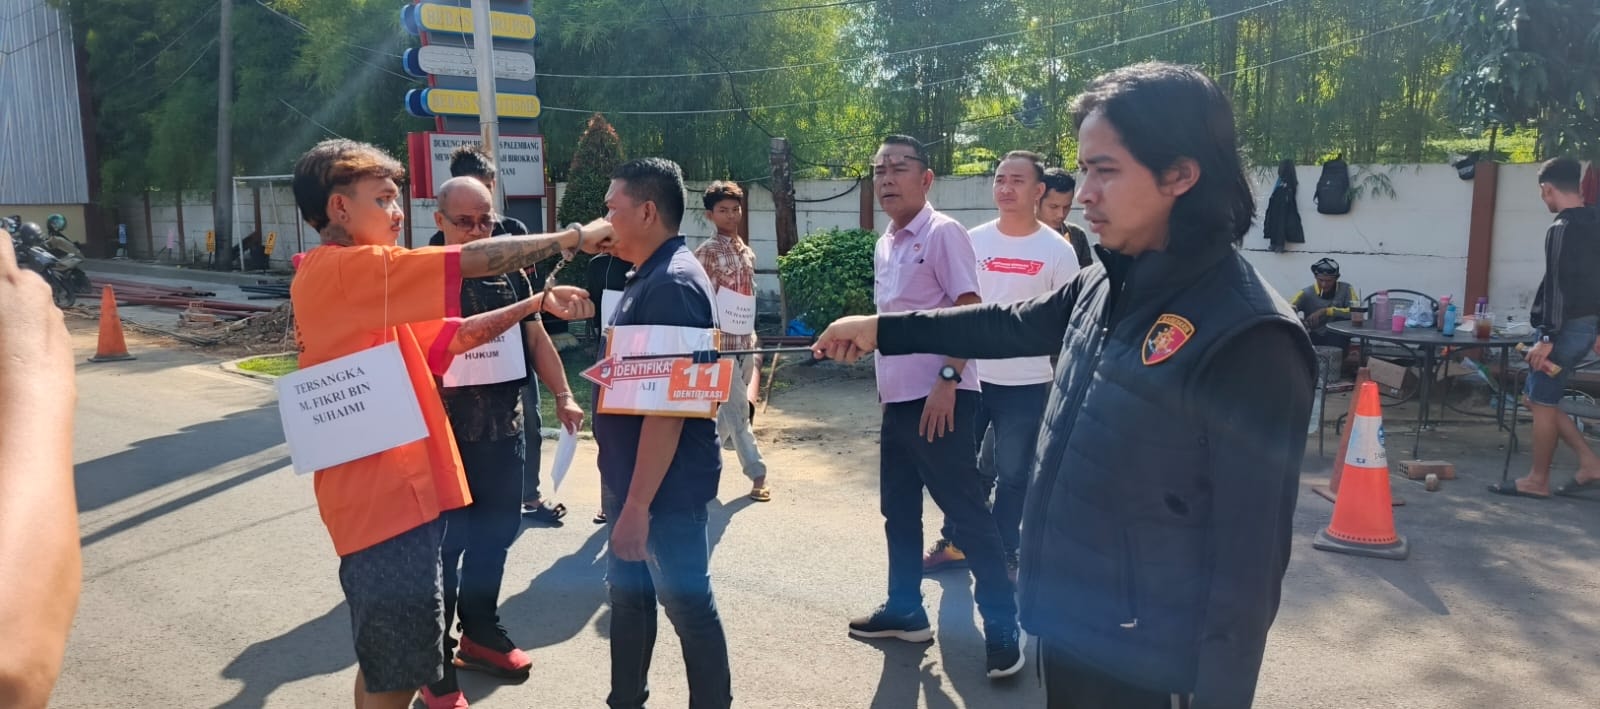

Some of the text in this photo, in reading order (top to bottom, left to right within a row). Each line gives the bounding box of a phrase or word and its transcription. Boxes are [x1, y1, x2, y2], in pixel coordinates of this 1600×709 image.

[503, 142, 539, 150] PALEMBANG
[508, 154, 540, 164] BIROKRASI
[464, 350, 500, 360] HUKUM
[294, 366, 366, 395] TERSANGKA
[683, 363, 720, 388] 11
[299, 381, 372, 412] M. FIKRI BIN
[673, 389, 723, 399] IDENTIFIKASI
[312, 401, 366, 425] SUHAIMI
